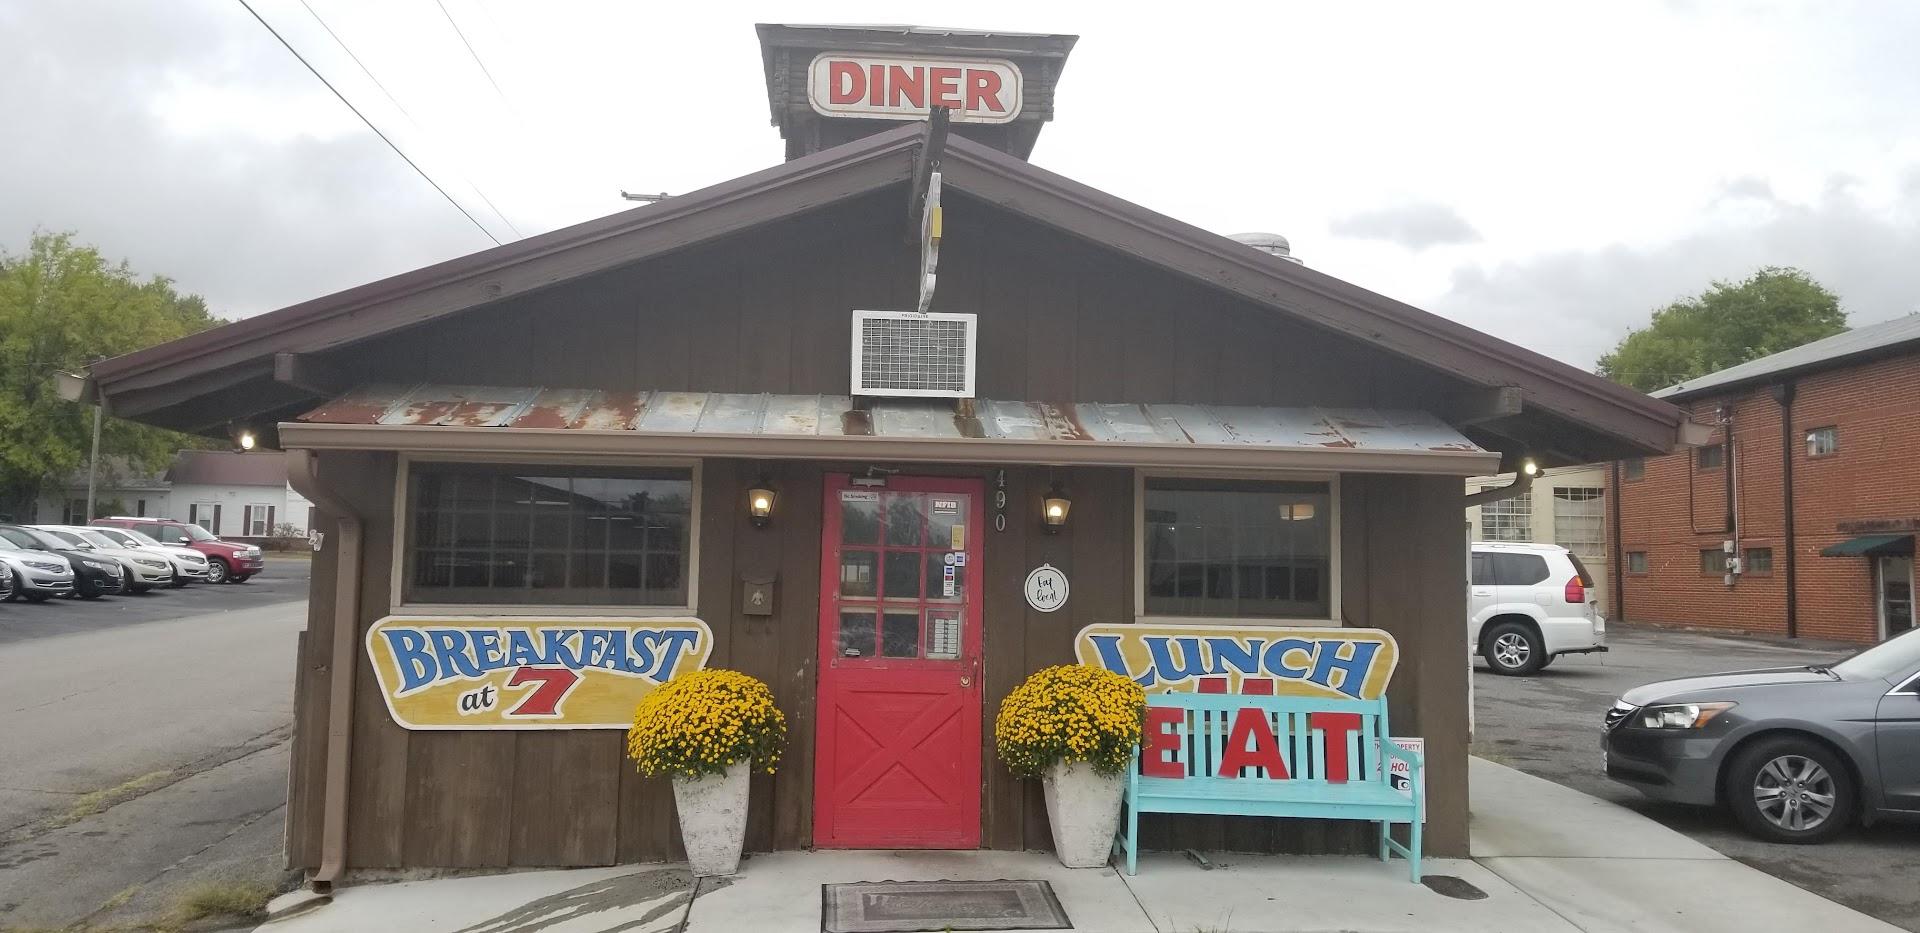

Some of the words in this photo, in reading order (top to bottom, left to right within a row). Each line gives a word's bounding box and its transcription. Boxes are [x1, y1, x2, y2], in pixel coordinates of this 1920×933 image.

[829, 61, 1006, 112] DINER
[934, 501, 957, 509] NFIB
[996, 470, 1006, 531] 490
[380, 630, 699, 693] BREAKFAST
[462, 686, 495, 712] at
[507, 667, 579, 715] 7
[1088, 635, 1383, 700] LUNCH
[1143, 707, 1361, 784] EAT
